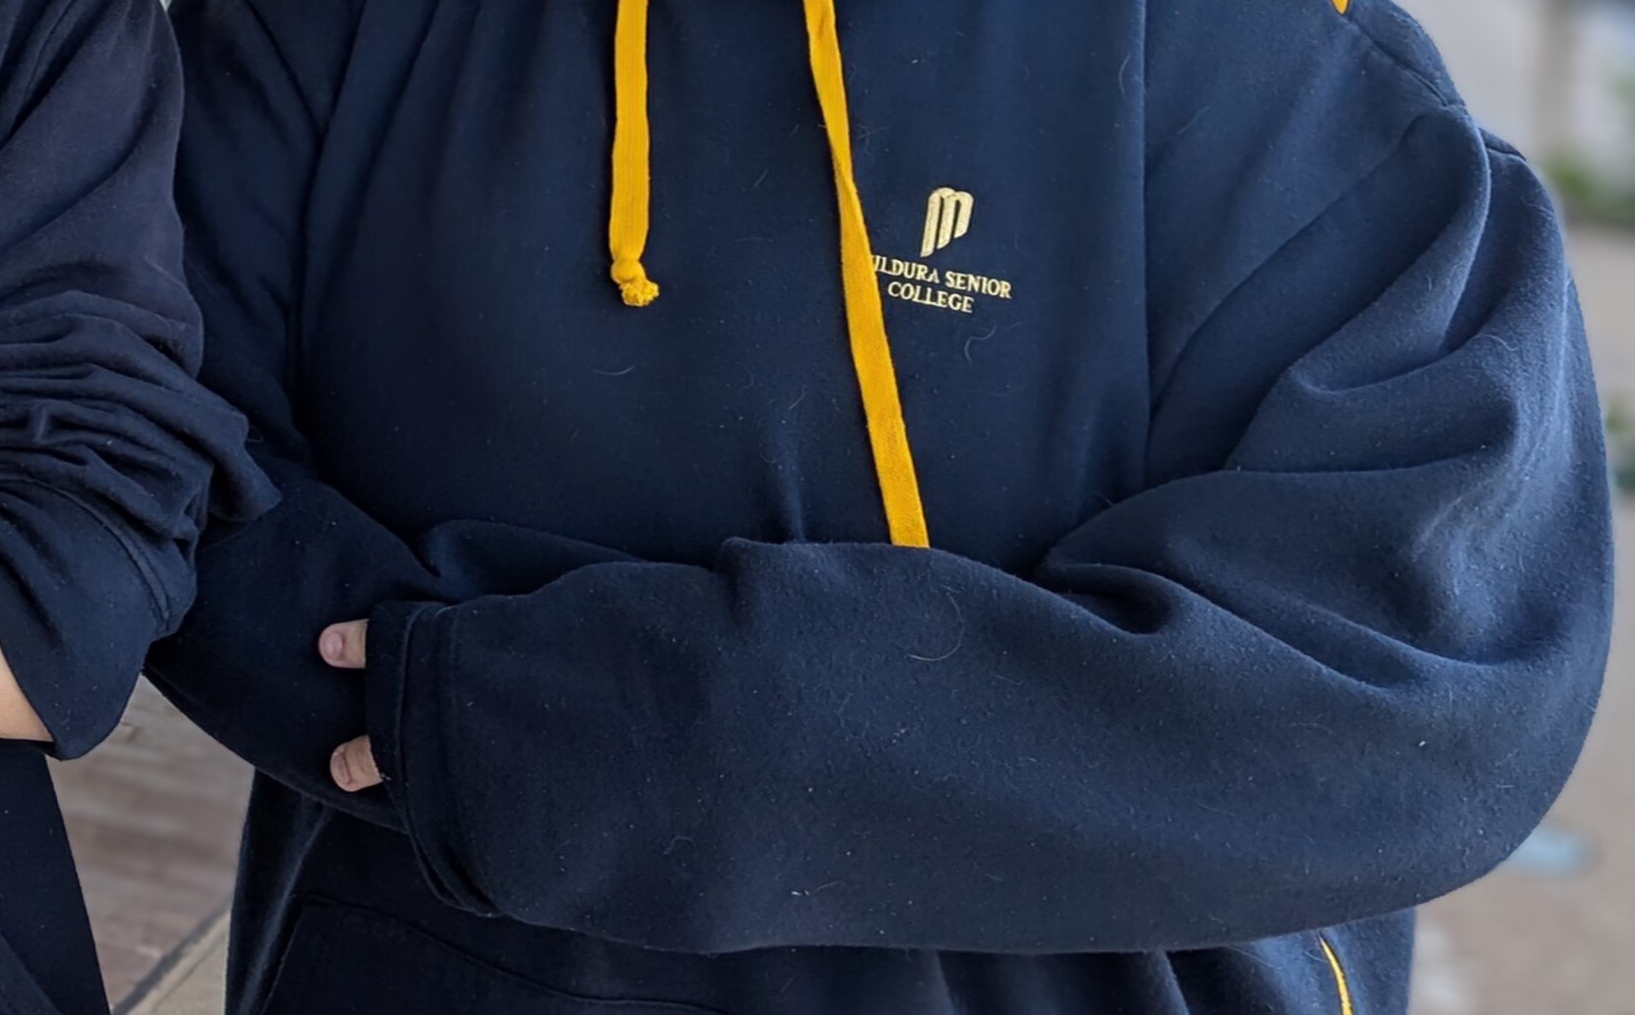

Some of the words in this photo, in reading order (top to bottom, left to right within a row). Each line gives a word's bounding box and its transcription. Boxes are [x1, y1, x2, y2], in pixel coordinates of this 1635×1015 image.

[873, 254, 941, 284] ILDURA
[945, 270, 1013, 300] SENIOR
[887, 281, 975, 314] COLLEGE
